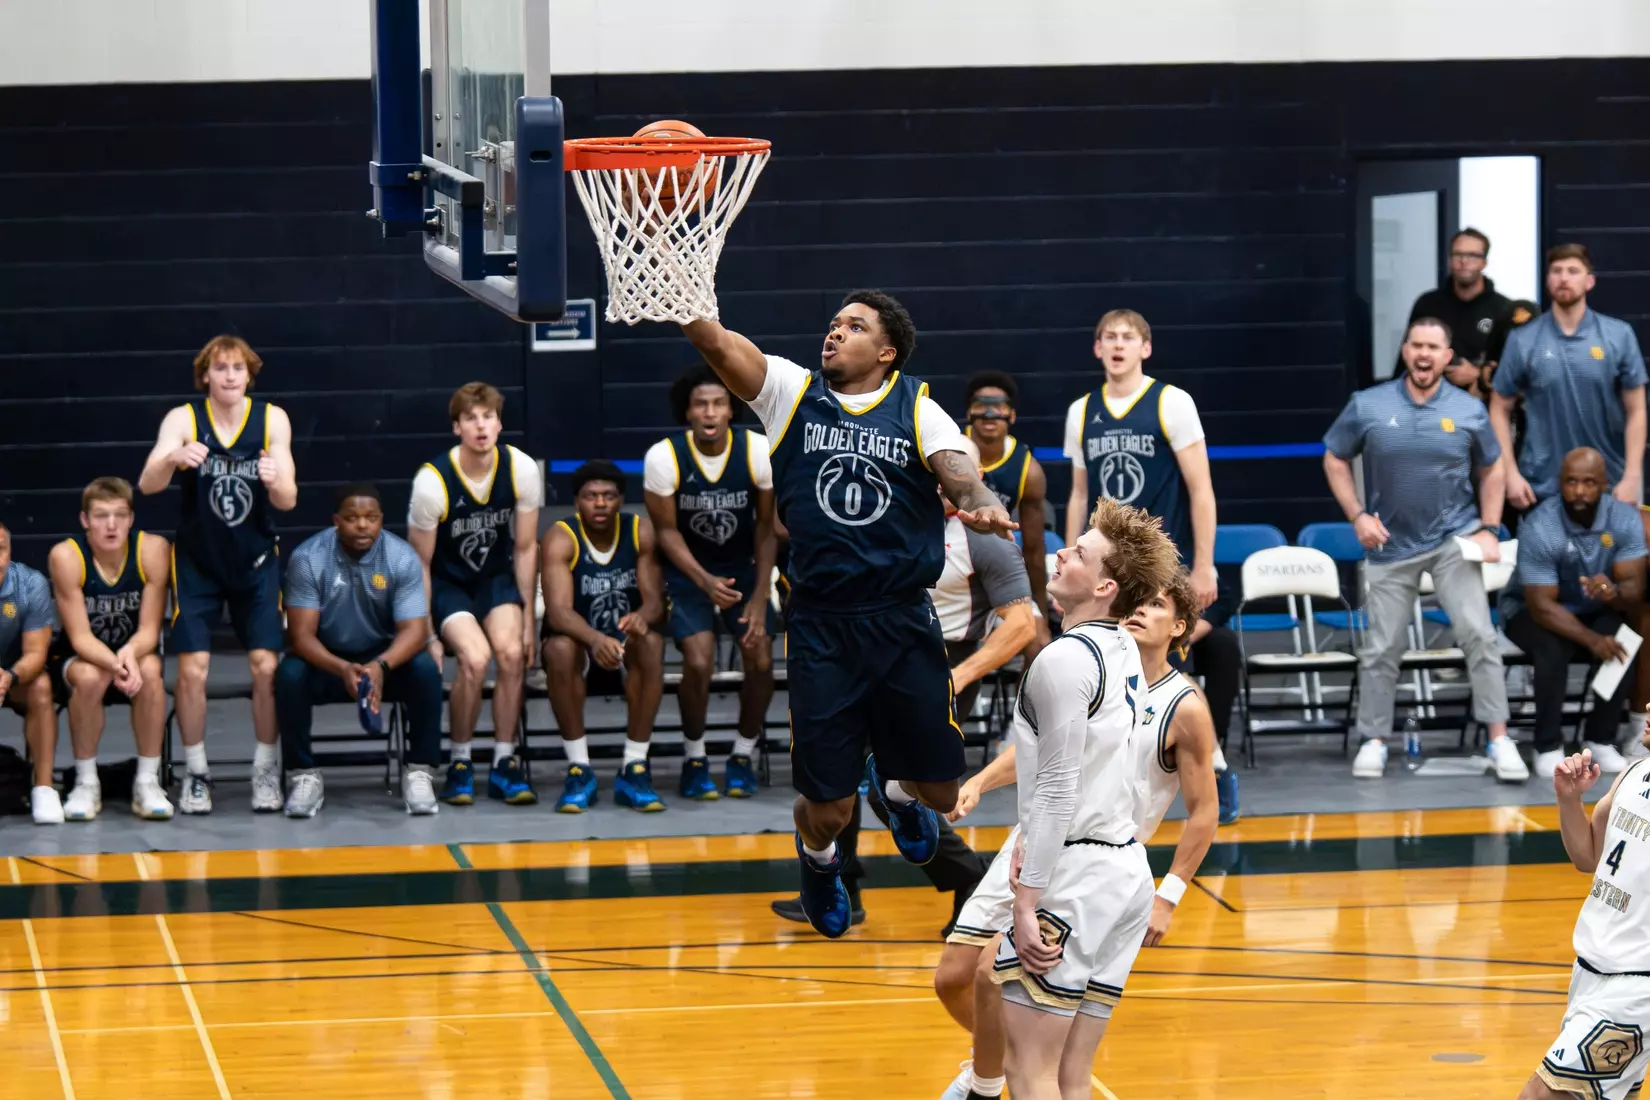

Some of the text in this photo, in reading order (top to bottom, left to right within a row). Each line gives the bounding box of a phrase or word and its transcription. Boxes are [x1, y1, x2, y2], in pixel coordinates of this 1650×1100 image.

[804, 422, 910, 468] GOLDEN EAGLES
[1087, 434, 1155, 461] GOLDEN EAGLES
[229, 459, 258, 480] EAGLE
[844, 482, 862, 515] 0
[1116, 473, 1124, 498] 1
[222, 495, 235, 520] 5
[479, 546, 490, 569] 7
[1257, 563, 1326, 577] SPARTANS
[1605, 840, 1627, 876] 4
[1589, 878, 1632, 914] STERN
